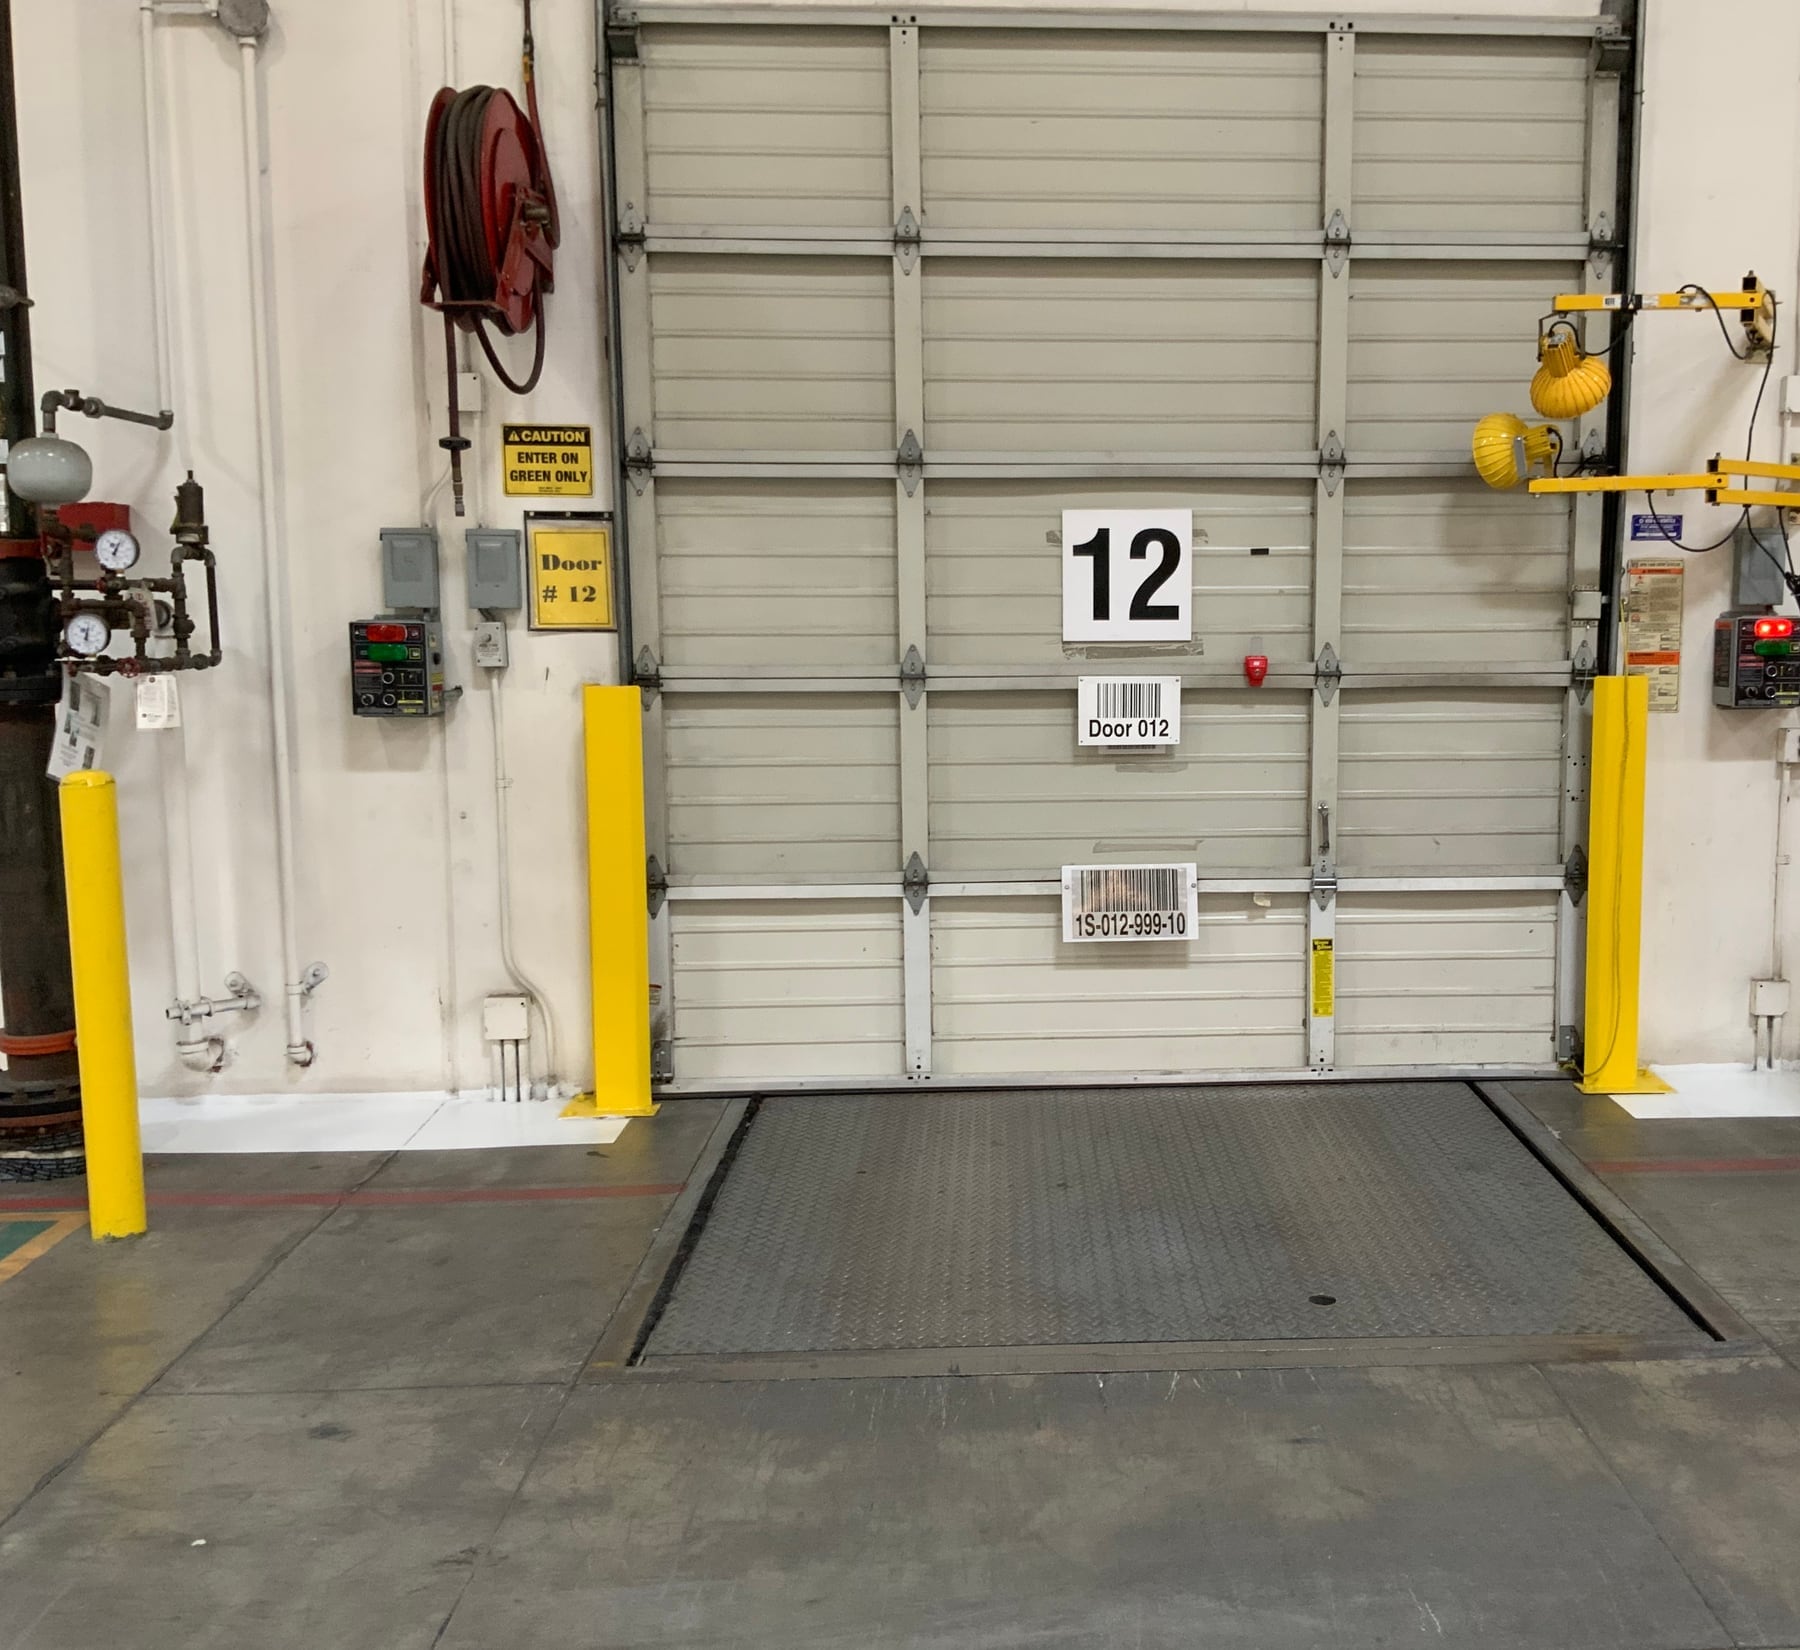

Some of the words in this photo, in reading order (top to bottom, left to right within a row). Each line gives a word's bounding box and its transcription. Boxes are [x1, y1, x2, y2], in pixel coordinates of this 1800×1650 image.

[521, 430, 585, 443] CAUTION
[517, 452, 557, 464] ENTER
[561, 452, 579, 465] ON
[509, 469, 551, 482] GREEN
[555, 470, 588, 483] ONLY
[541, 553, 602, 571] Door
[1072, 527, 1181, 621] 12
[542, 585, 558, 602] #
[569, 585, 597, 603] 12
[1089, 719, 1132, 738] Door
[1137, 719, 1169, 738] 012
[1075, 912, 1186, 937] 1S-012-999-10
